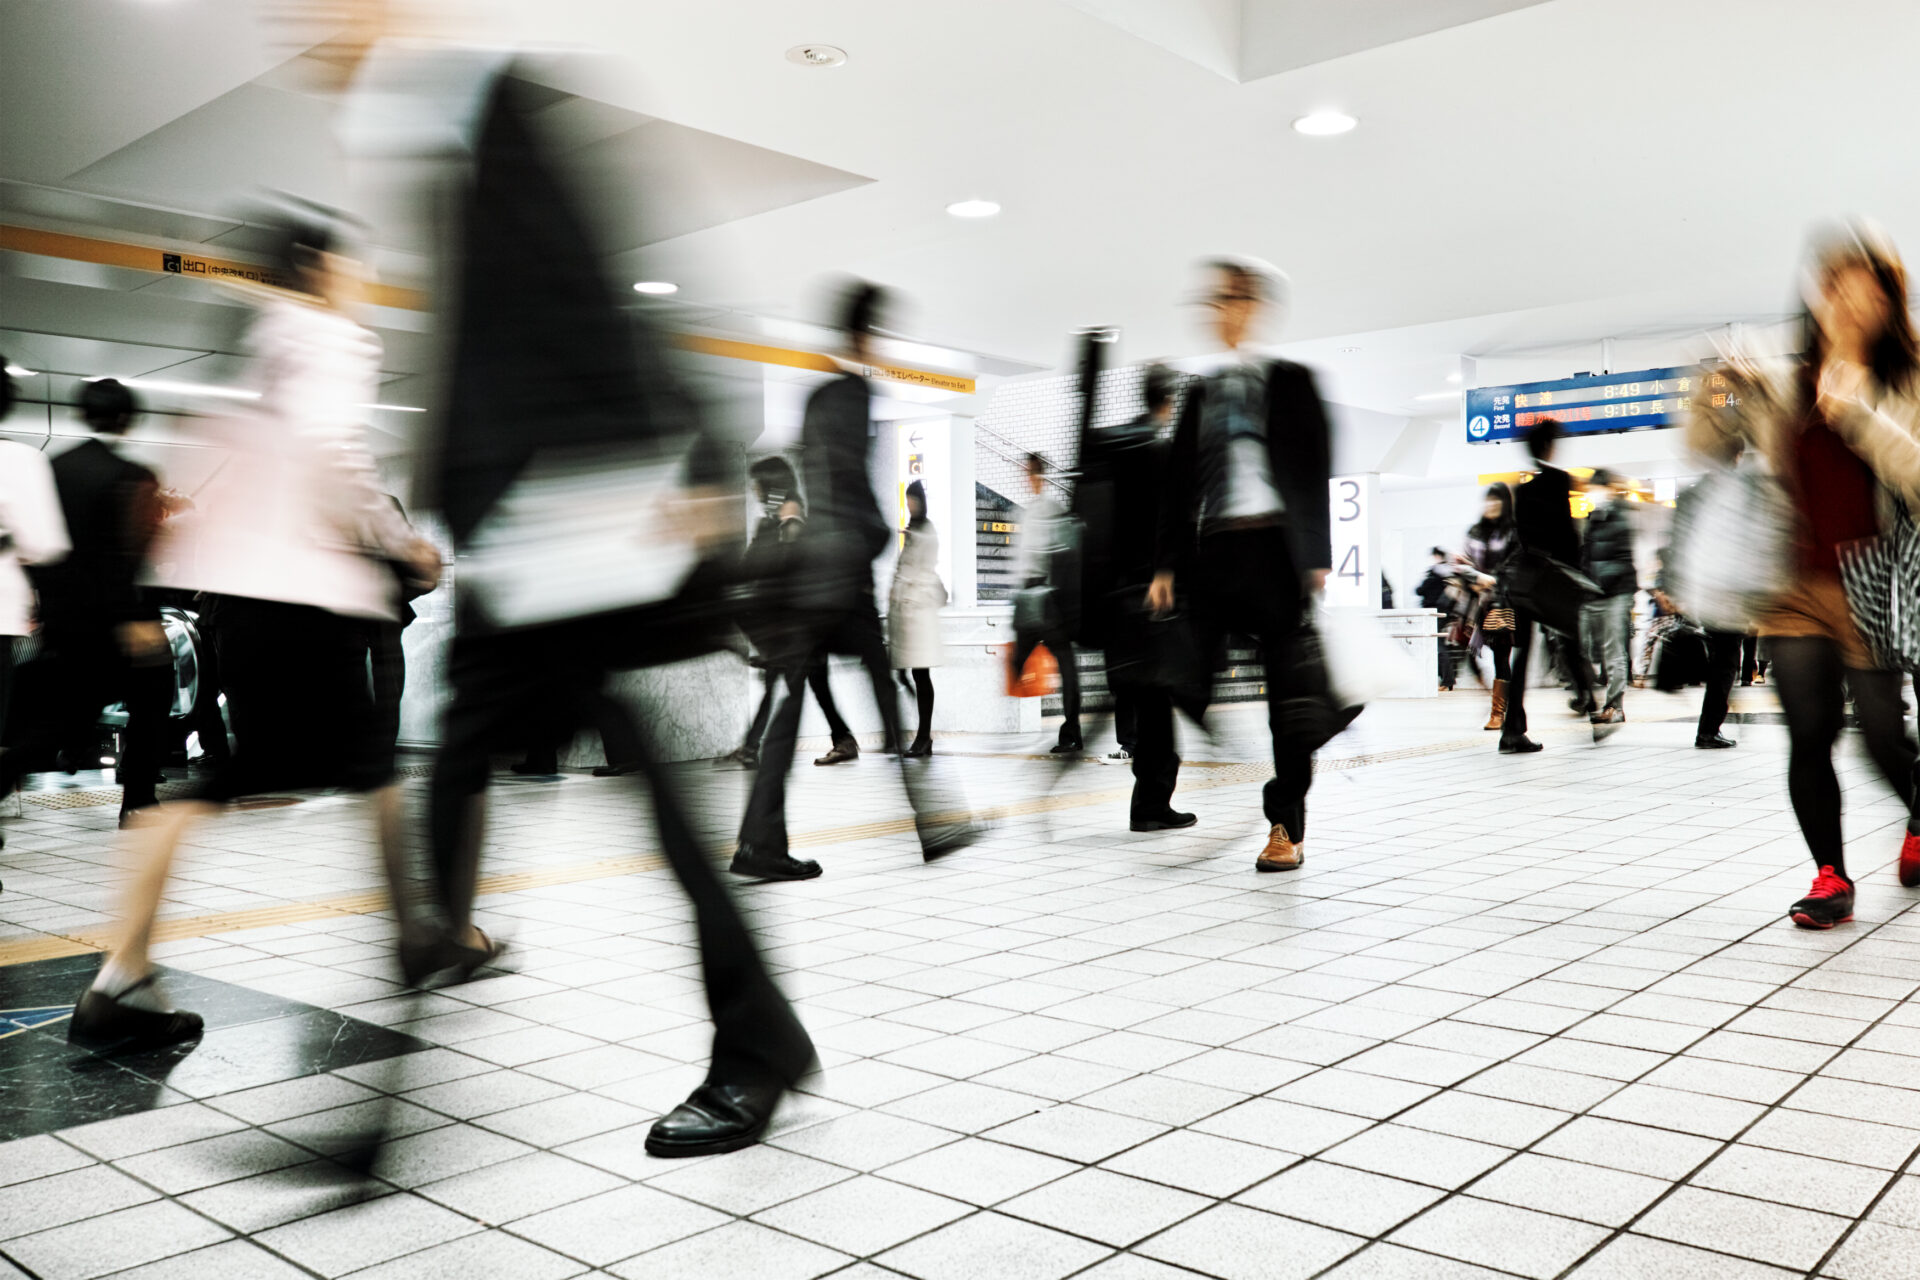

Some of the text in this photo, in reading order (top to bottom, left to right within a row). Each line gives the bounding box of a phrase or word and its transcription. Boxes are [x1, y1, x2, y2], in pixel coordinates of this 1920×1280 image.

[167, 261, 180, 273] C1
[183, 259, 206, 274] 出口
[1603, 383, 1641, 399] 8:49
[1649, 377, 1692, 395] 小倉
[1603, 402, 1641, 418] 9:15
[1472, 417, 1486, 434] 4
[911, 462, 923, 475] C1
[1338, 480, 1361, 522] 3
[1337, 544, 1365, 587] 4
